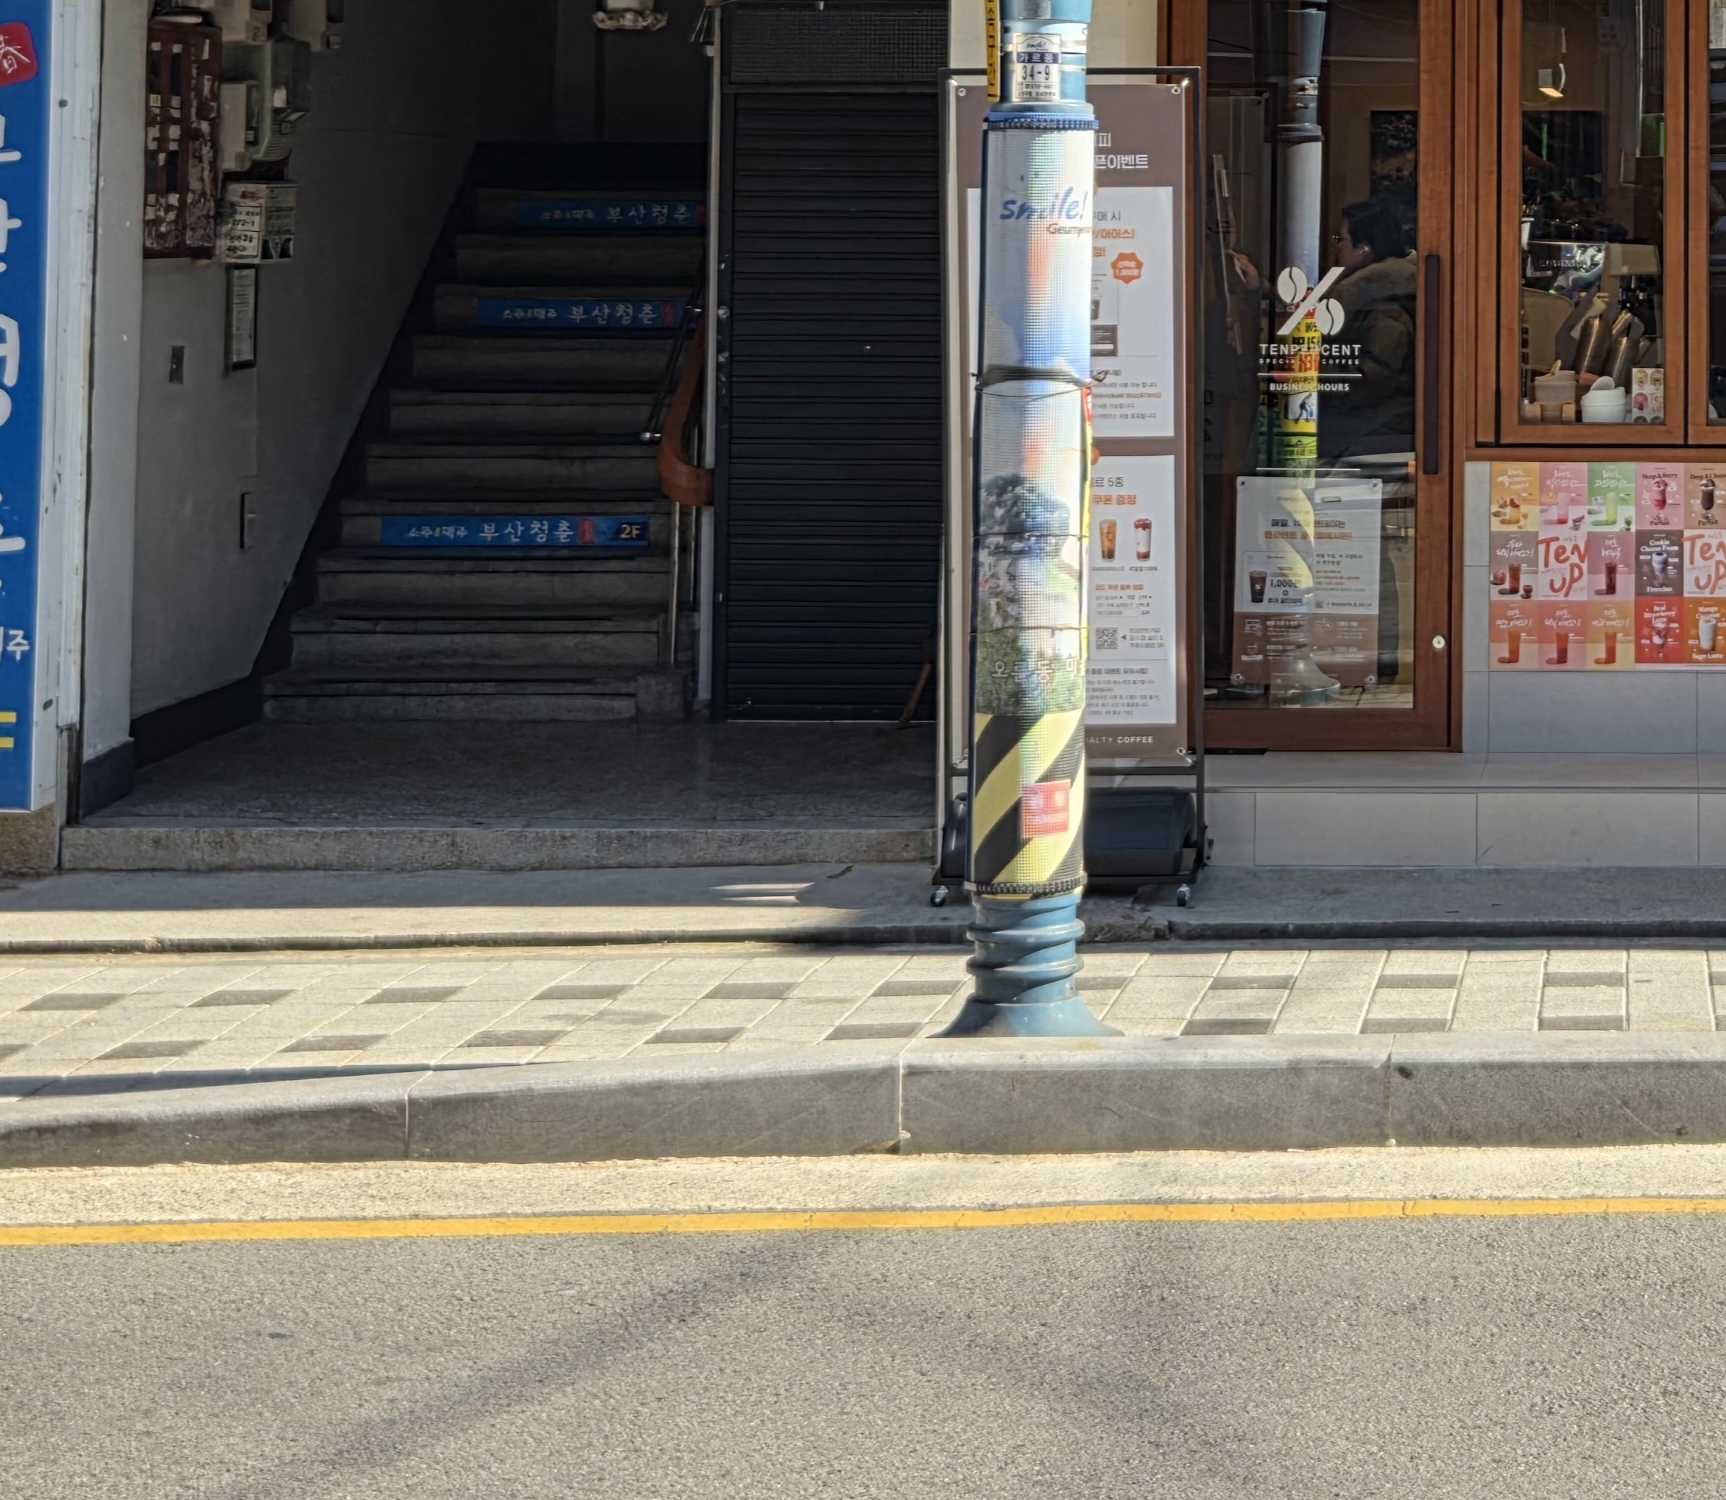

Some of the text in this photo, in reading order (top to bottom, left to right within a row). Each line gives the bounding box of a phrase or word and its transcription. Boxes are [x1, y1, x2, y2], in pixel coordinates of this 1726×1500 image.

[1021, 64, 1051, 81] 34-9
[1094, 132, 1112, 148] 피
[1094, 153, 1150, 170] 픈이벤트
[1093, 210, 1121, 222] 매 시
[1094, 227, 1136, 240] /아이스)
[1269, 382, 1351, 392] BUSINE HOURS
[619, 523, 642, 540] 2F
[0, 628, 31, 662] 주
[1116, 735, 1155, 745] COFFEE
